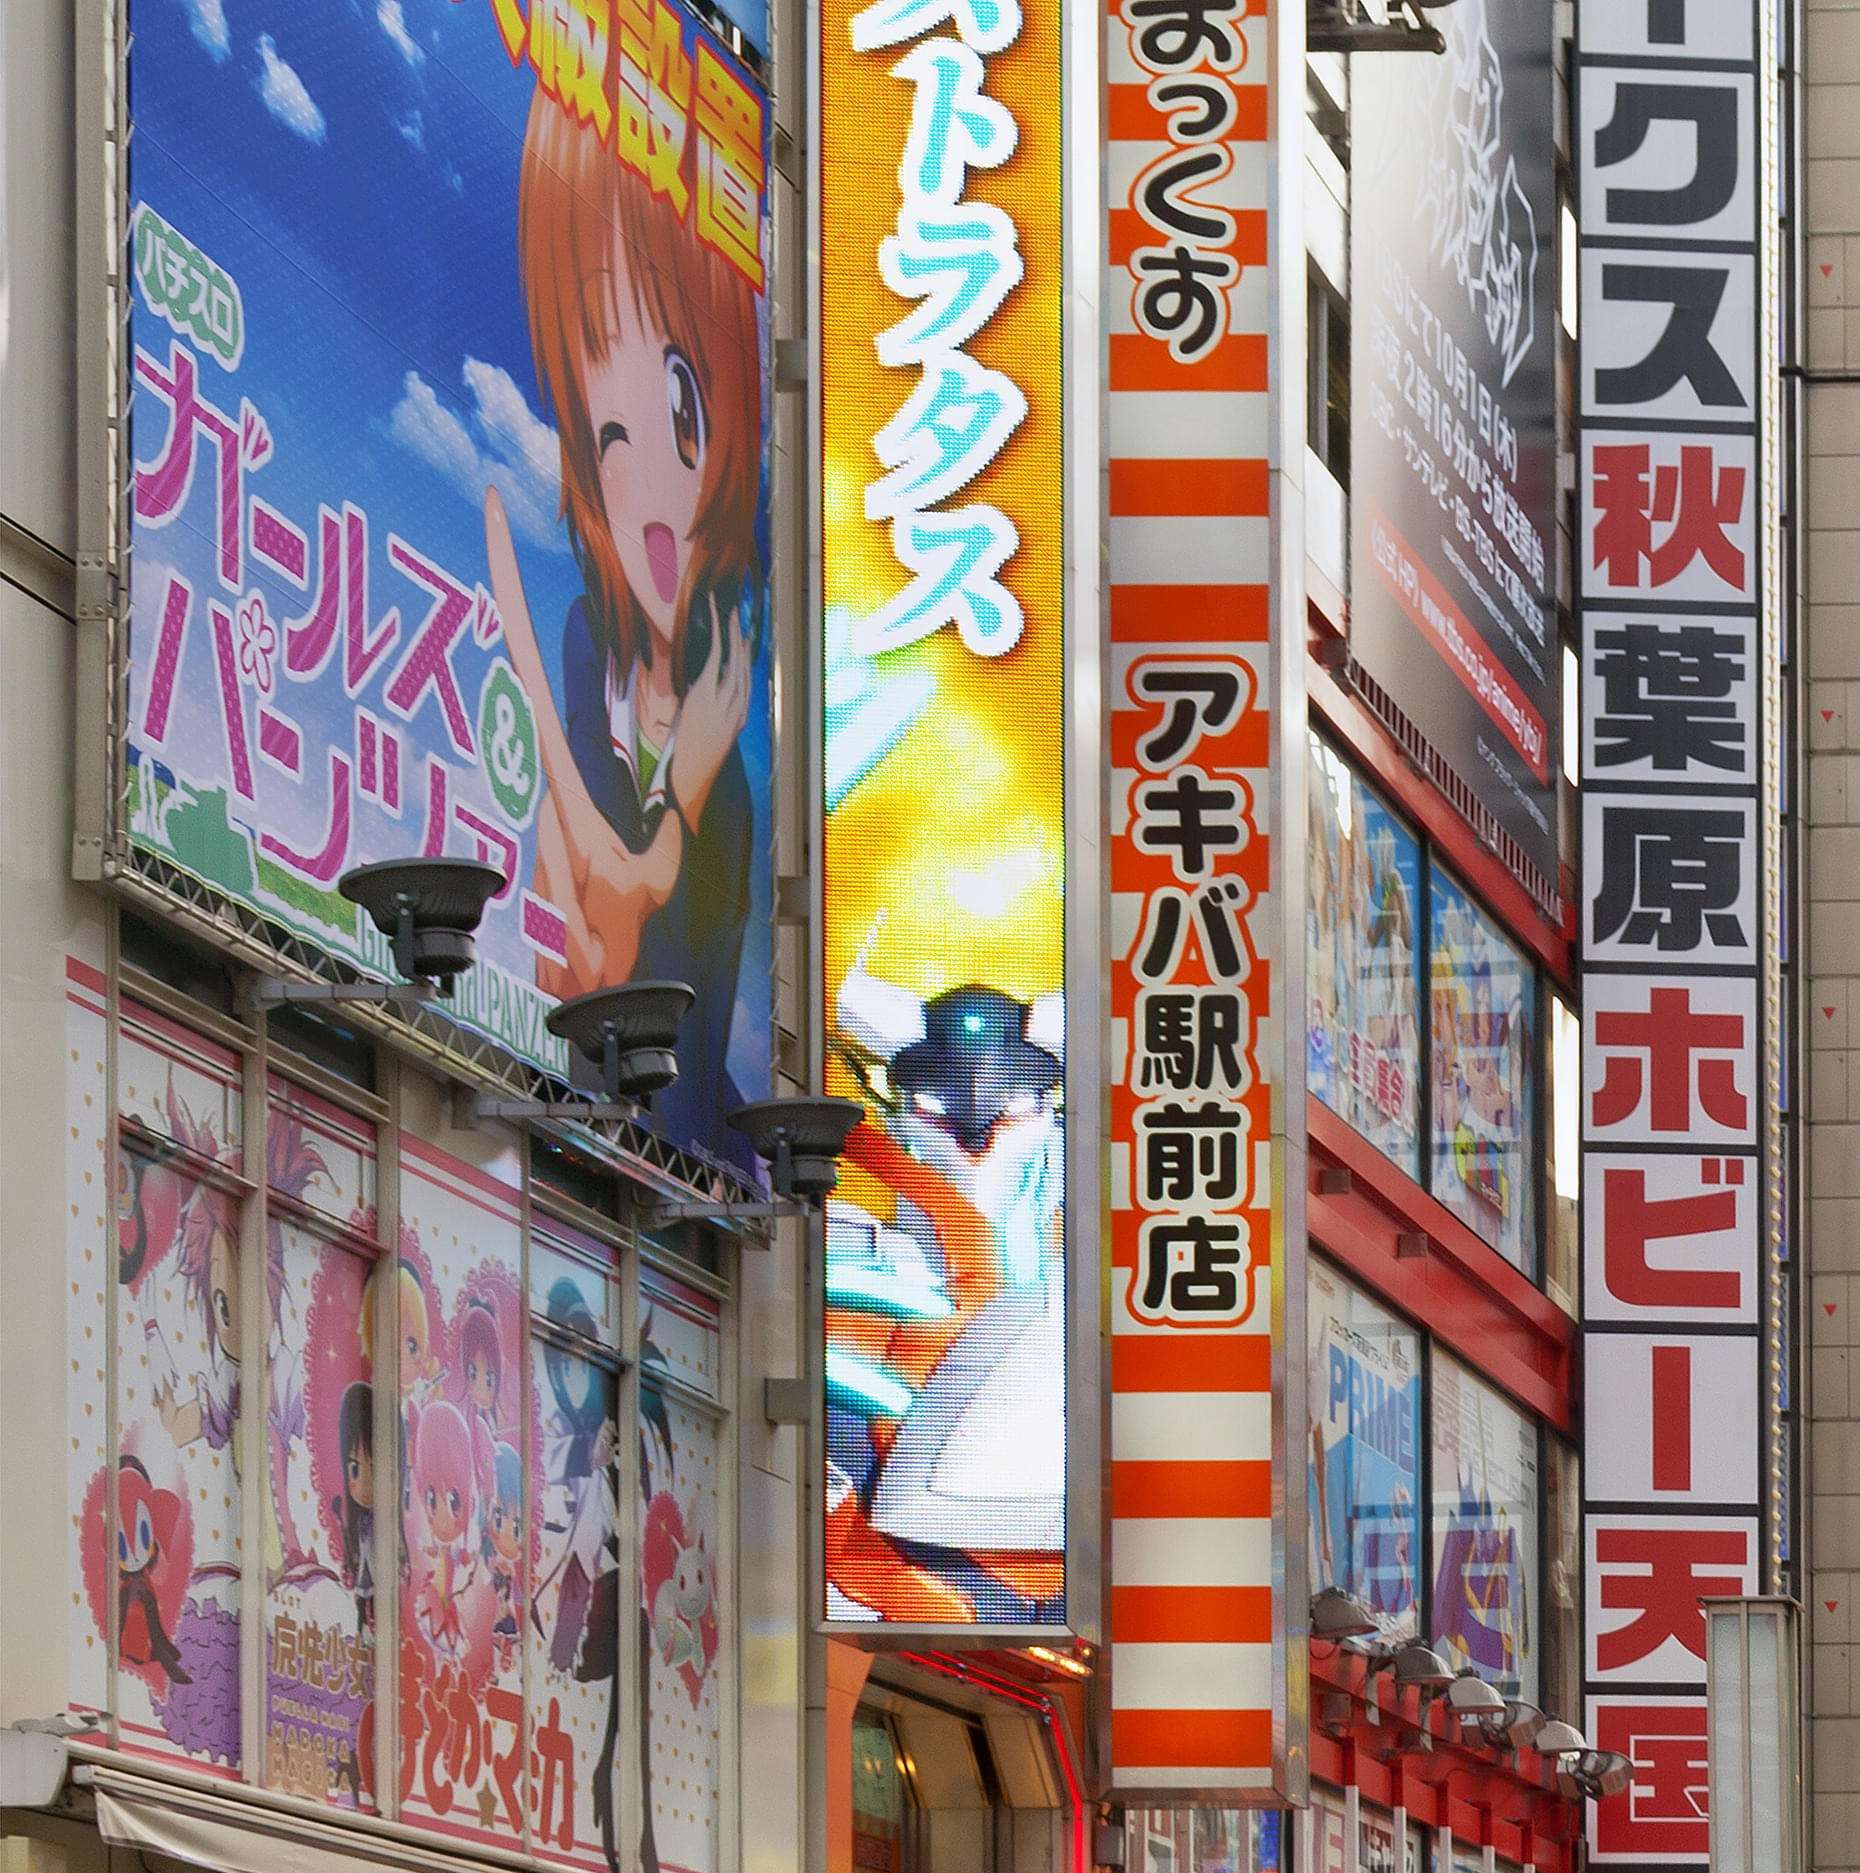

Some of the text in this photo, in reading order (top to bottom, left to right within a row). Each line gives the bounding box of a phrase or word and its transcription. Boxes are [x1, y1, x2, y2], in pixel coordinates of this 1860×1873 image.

[138, 232, 238, 360] パチスロ
[1139, 668, 1246, 1312] アキバ駅前店
[1328, 1342, 1415, 1476] PRIME
